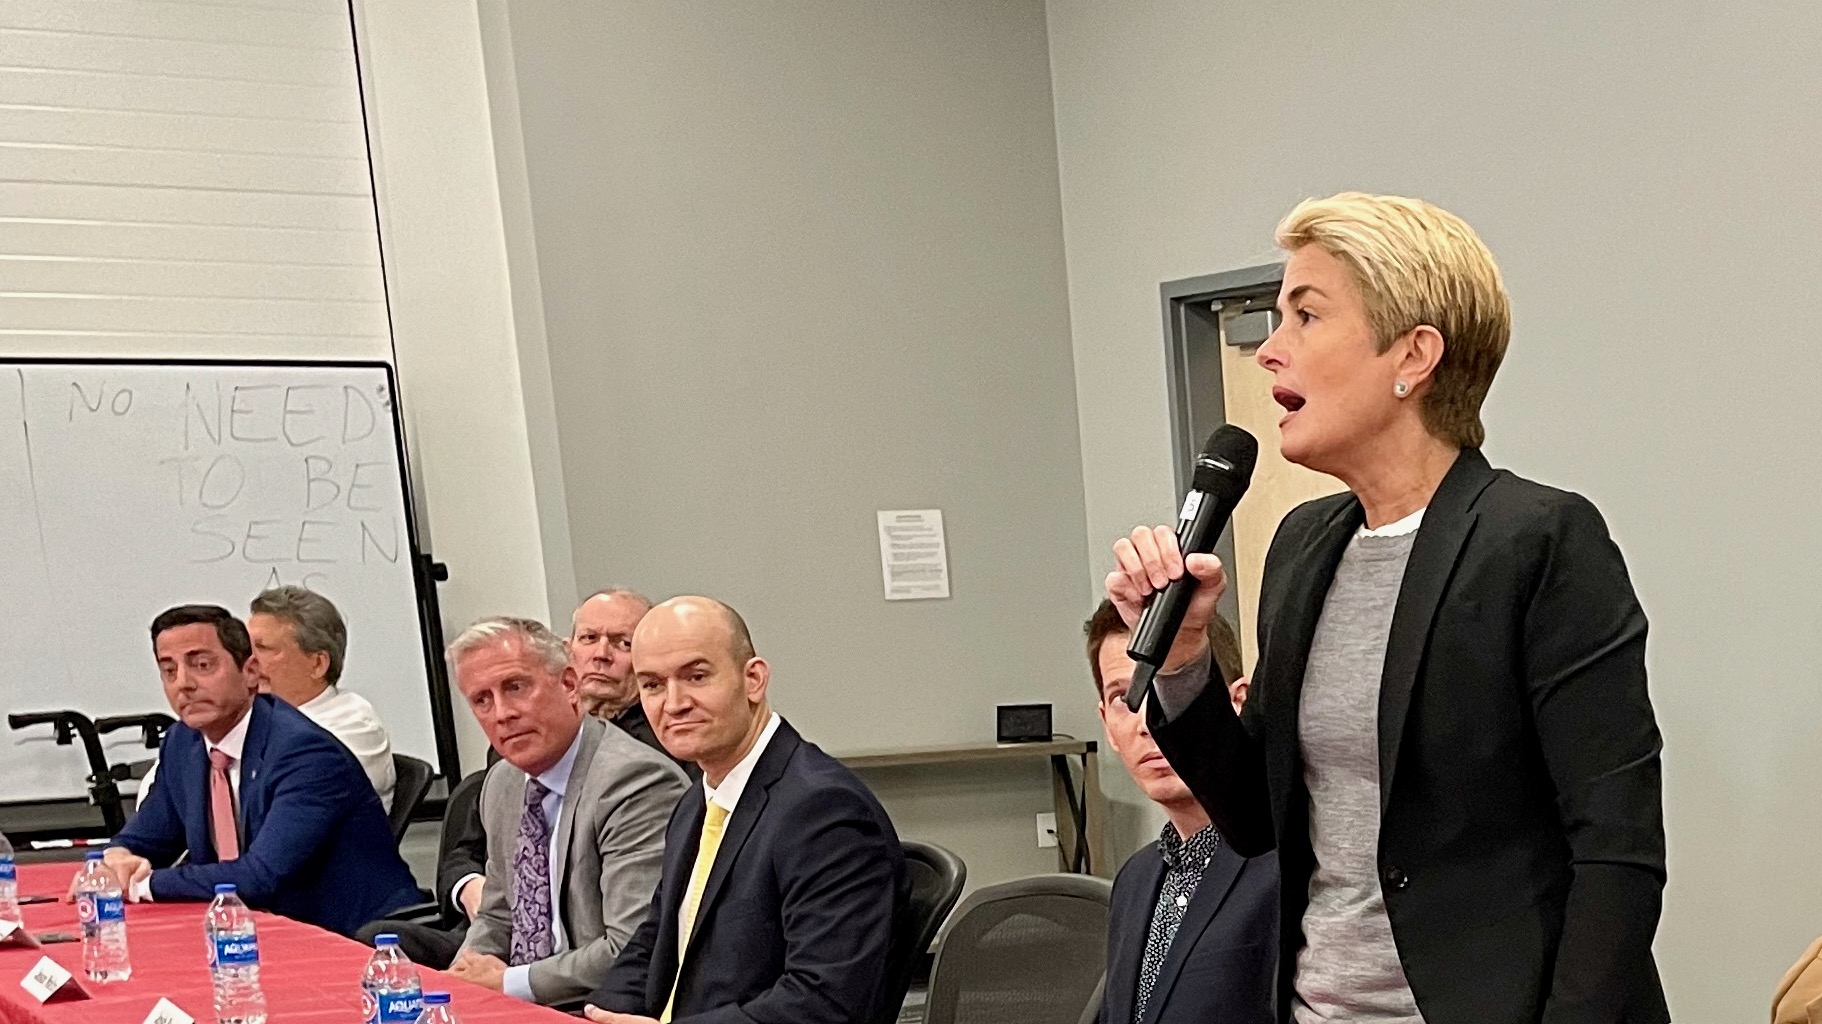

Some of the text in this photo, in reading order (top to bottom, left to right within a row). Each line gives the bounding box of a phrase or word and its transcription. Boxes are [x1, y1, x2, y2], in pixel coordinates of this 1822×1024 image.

[69, 380, 377, 451] NO NEED
[158, 453, 391, 512] TO BE
[189, 514, 400, 565] SEEN
